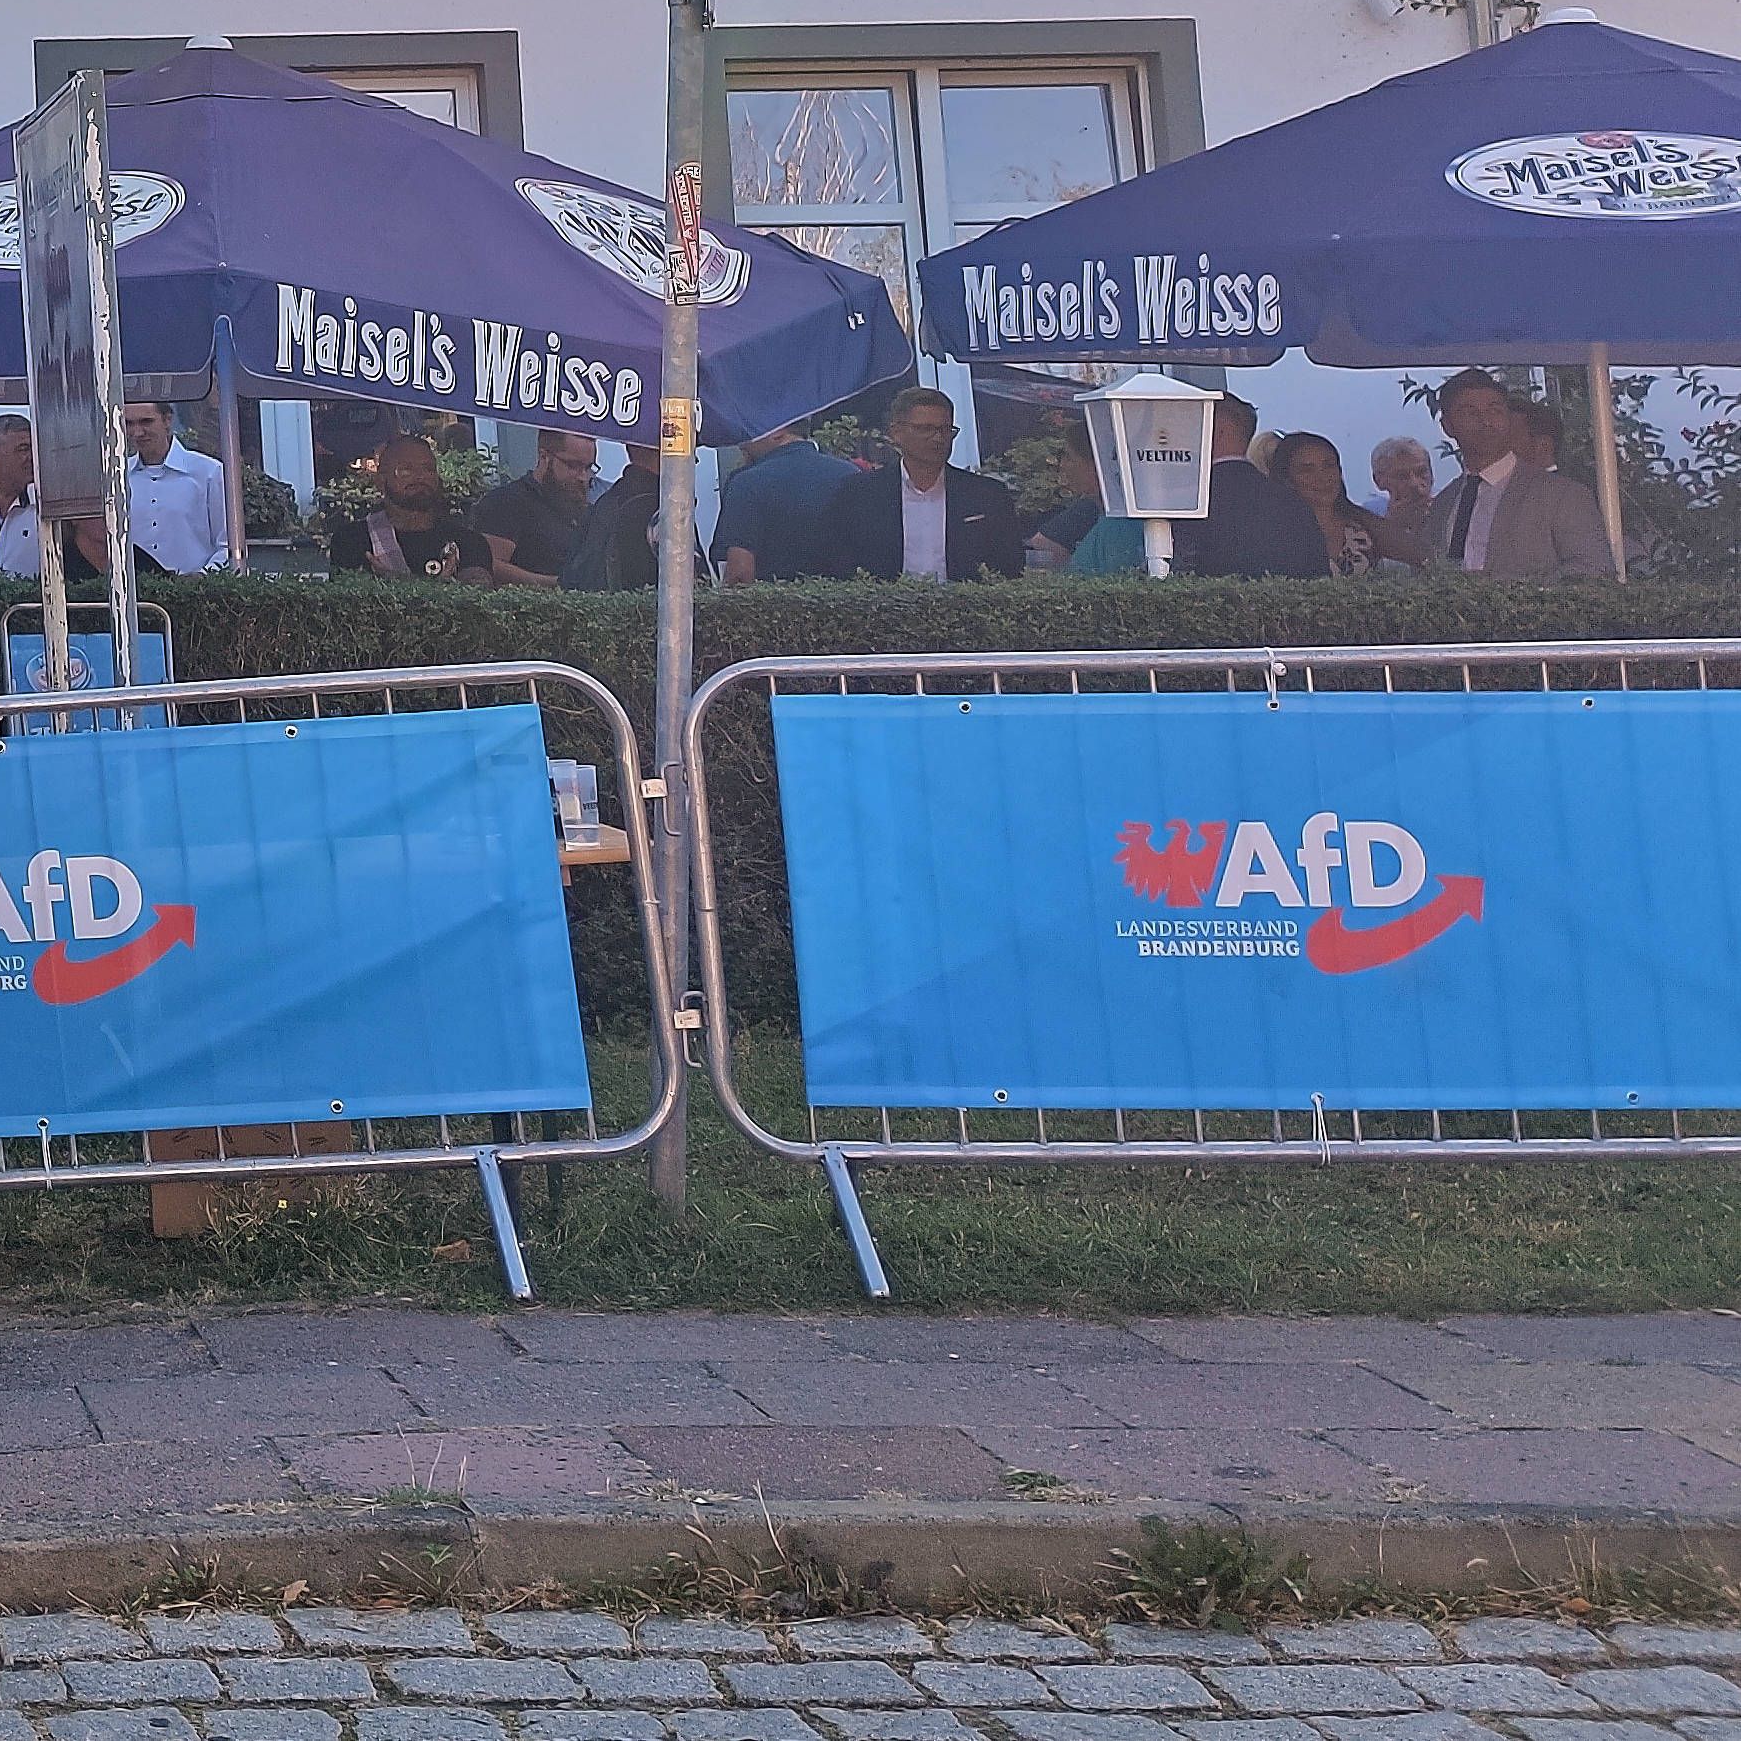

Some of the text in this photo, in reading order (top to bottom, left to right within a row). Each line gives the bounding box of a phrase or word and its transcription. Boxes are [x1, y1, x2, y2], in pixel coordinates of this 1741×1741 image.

[1488, 137, 1692, 196] Maisel's
[1576, 157, 1741, 197] Weiss
[962, 252, 1282, 351] Maisel's Weisse
[275, 282, 641, 427] Maisel's Weisse
[1136, 449, 1192, 462] VELTINS
[1215, 811, 1427, 907] AfD
[1115, 920, 1299, 938] LANDESVERBAND
[1138, 939, 1301, 958] BRANDENBURG
